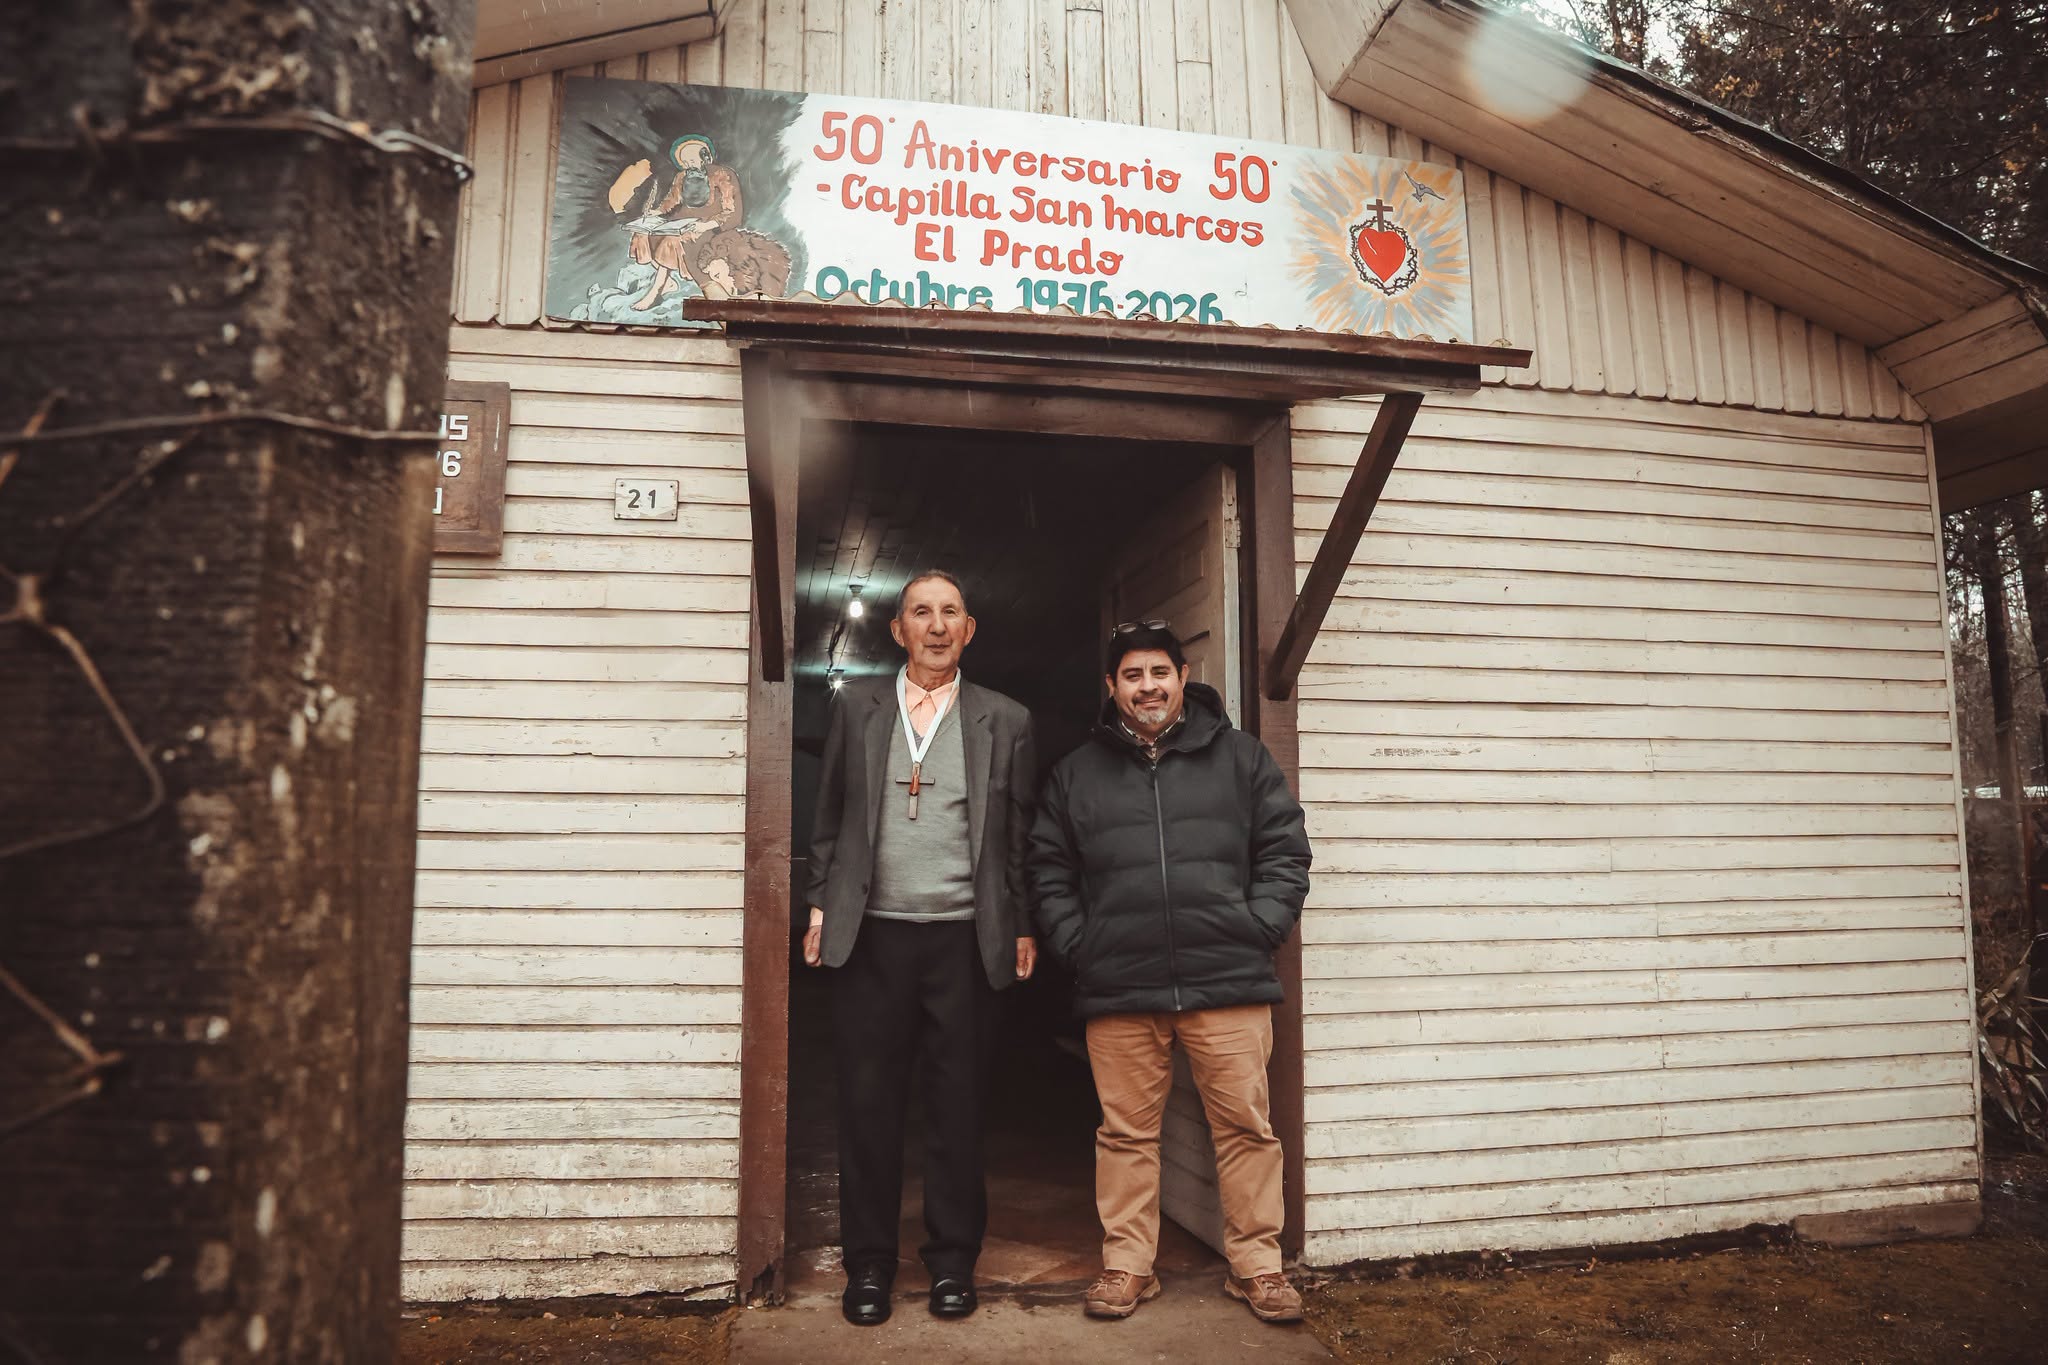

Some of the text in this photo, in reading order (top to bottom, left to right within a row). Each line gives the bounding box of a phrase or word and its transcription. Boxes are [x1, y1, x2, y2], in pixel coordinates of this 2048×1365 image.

[904, 119, 1182, 193] Aniversario
[1009, 186, 1093, 228] San
[914, 222, 1124, 276] El Prado
[816, 266, 994, 312] Octubre
[627, 488, 657, 509] 21
